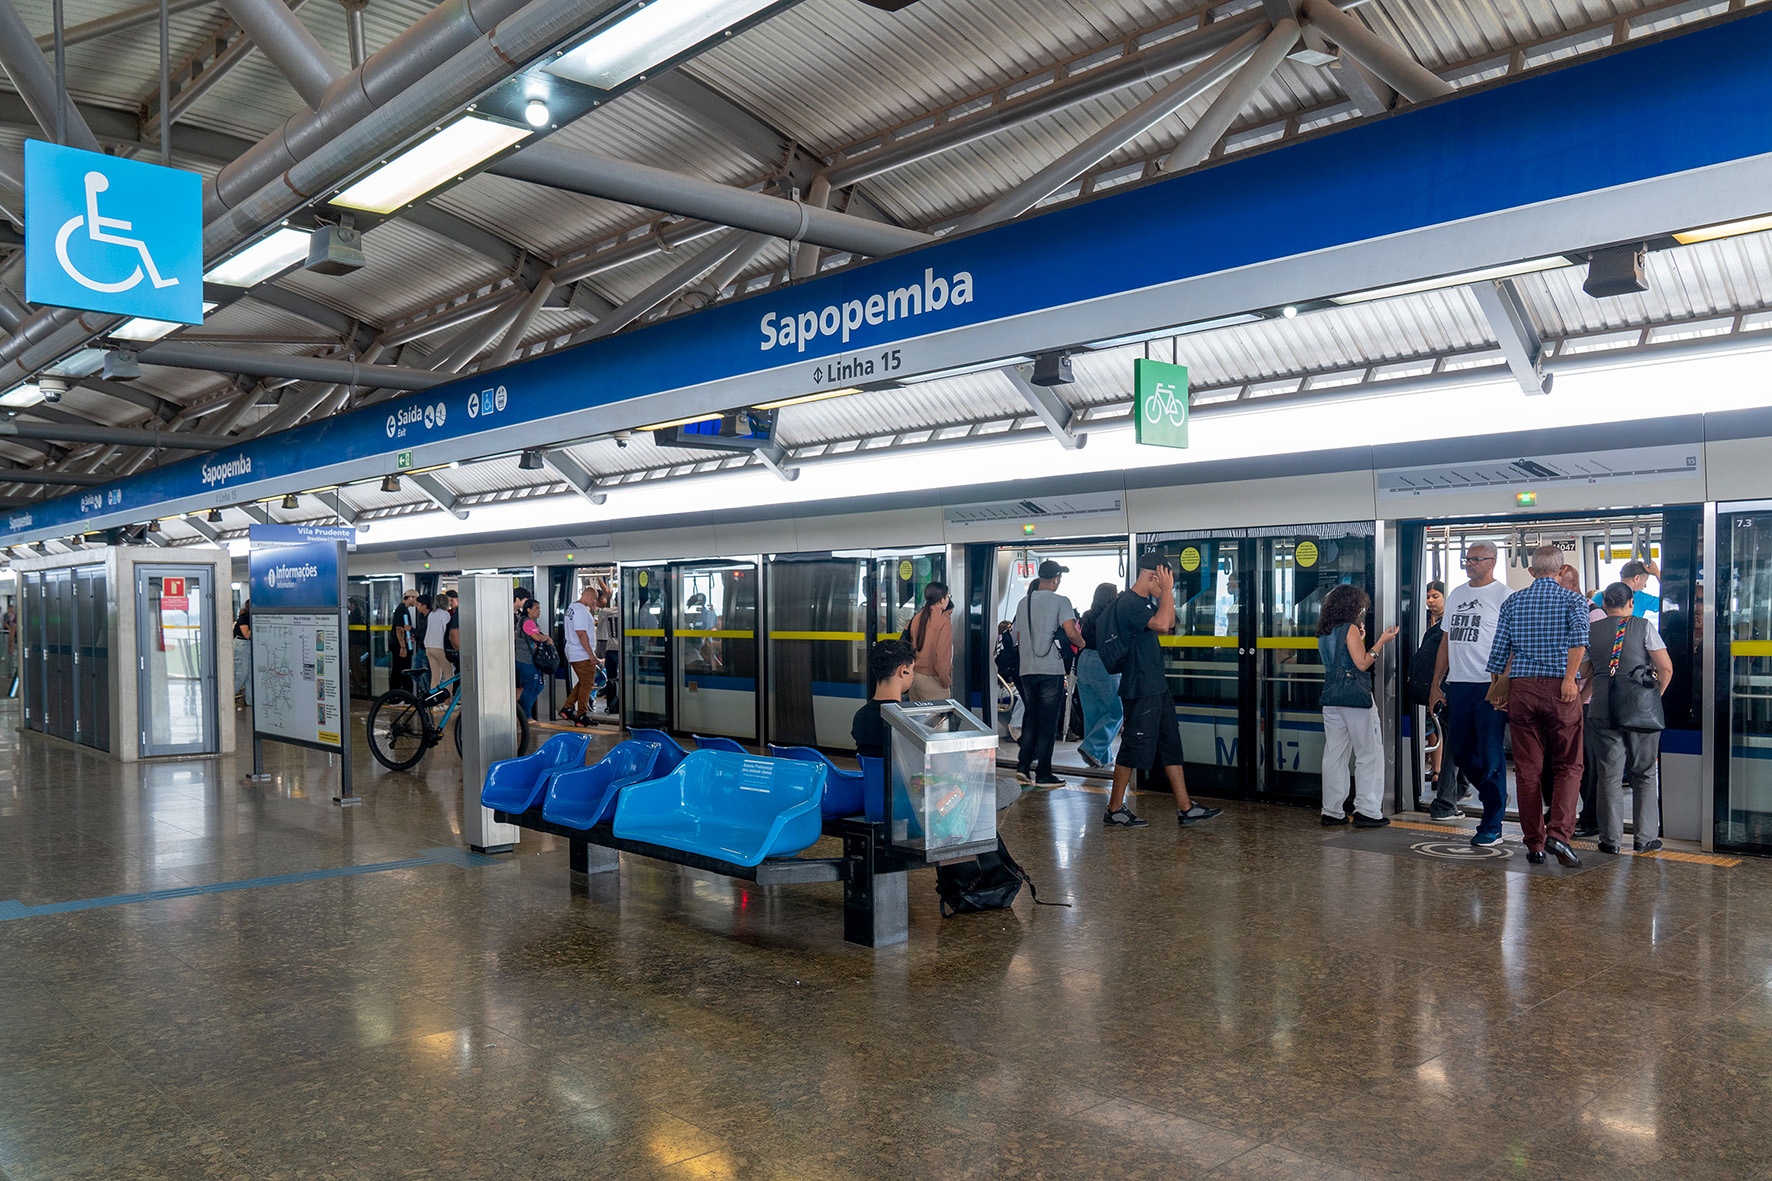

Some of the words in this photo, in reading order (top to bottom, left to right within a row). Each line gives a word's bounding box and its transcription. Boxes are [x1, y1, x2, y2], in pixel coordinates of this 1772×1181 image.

[760, 267, 974, 353] Sapopemba
[827, 357, 874, 384] Linha
[881, 349, 902, 372] 15
[397, 404, 423, 426] Saída
[397, 428, 407, 438] Exit
[202, 453, 252, 487] Sapopemba
[297, 527, 313, 535] Vila
[314, 528, 350, 537] Prudente
[1736, 519, 1752, 528] 7.3
[276, 563, 317, 581] Informações
